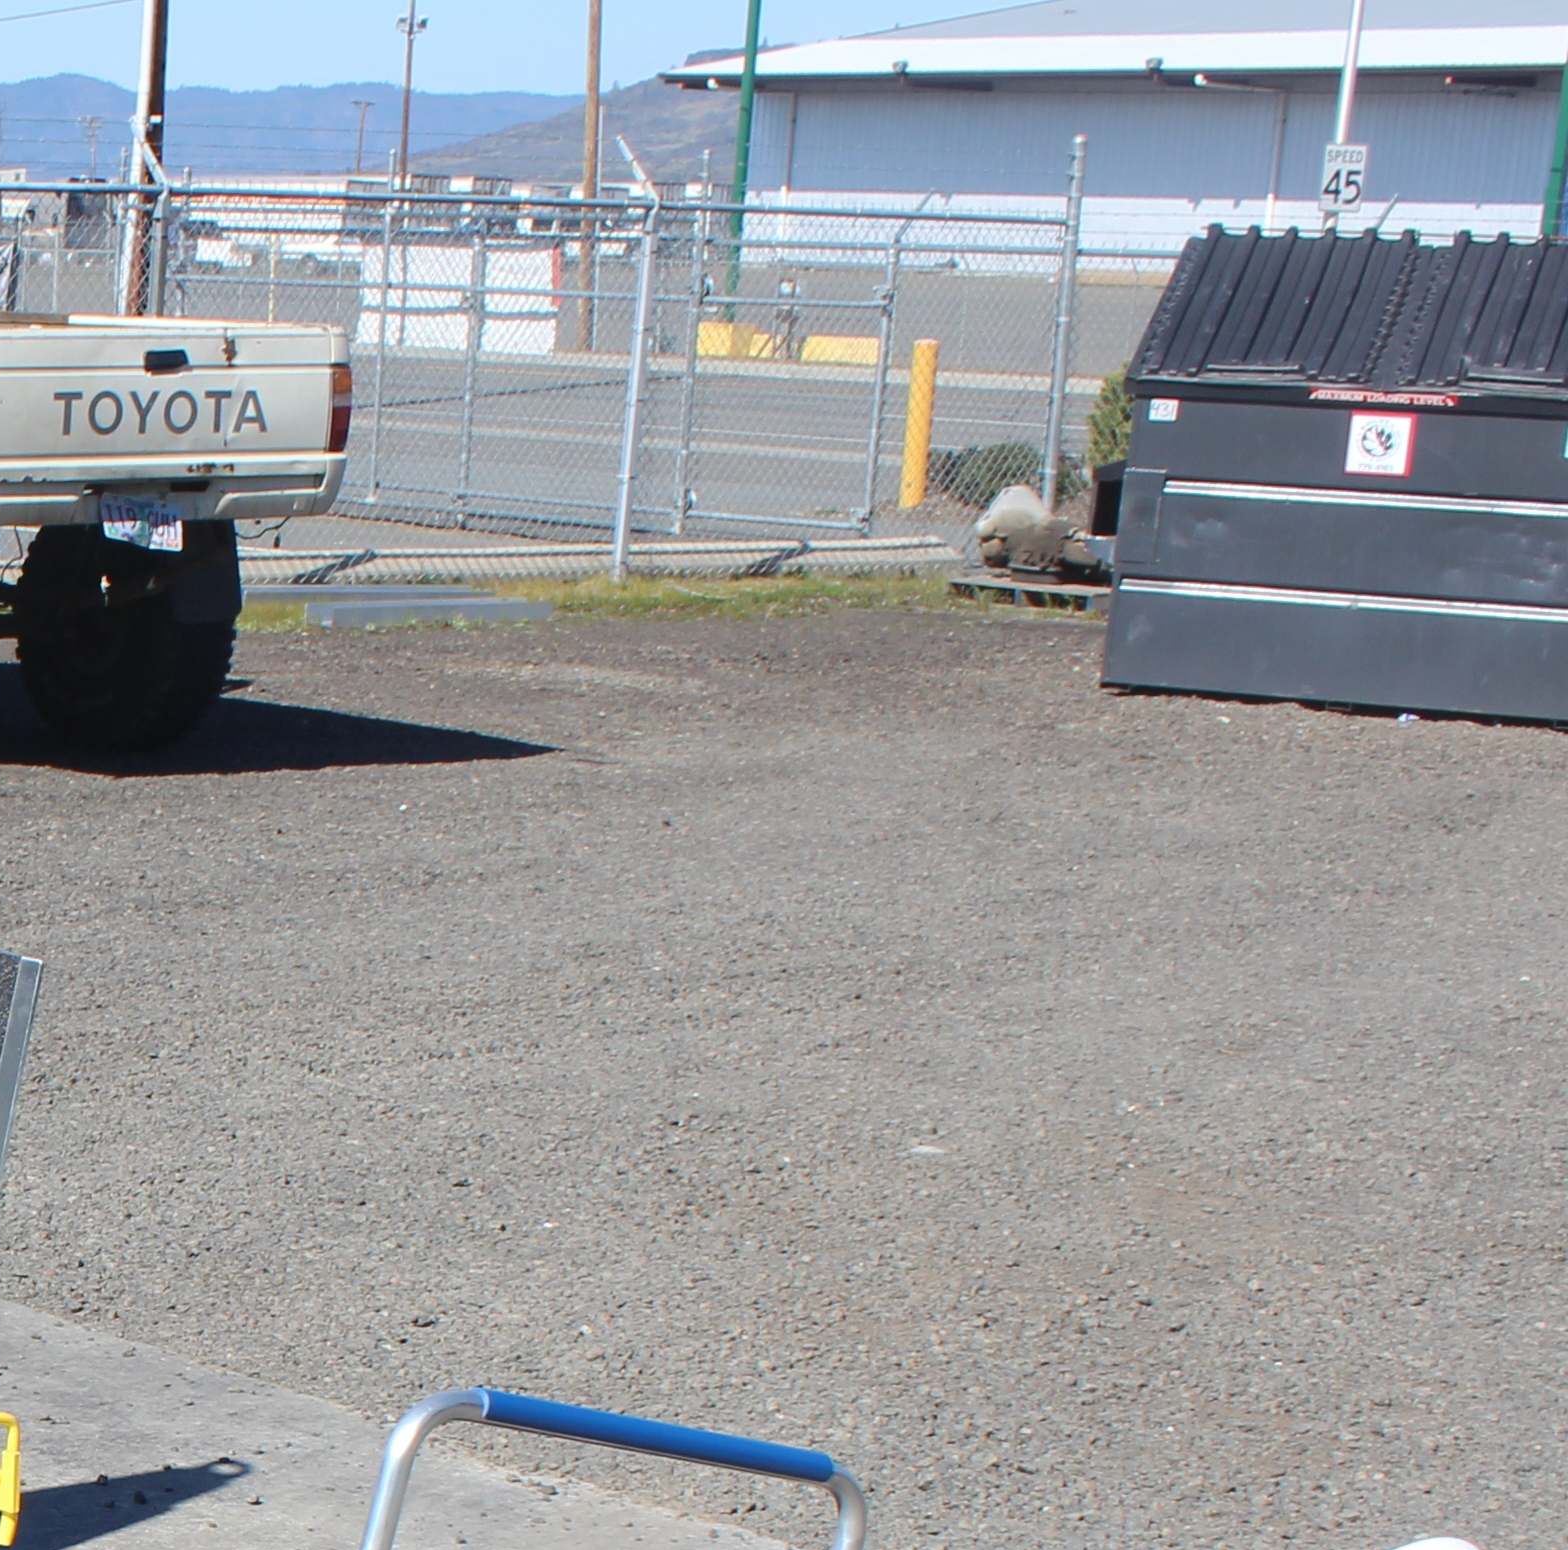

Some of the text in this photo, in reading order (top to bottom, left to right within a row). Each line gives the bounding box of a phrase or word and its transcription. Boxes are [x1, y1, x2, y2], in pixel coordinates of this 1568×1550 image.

[1327, 149, 1364, 164] SPEED
[1322, 168, 1363, 205] 45
[1367, 392, 1411, 405] LOADING
[1413, 395, 1446, 406] LEVEL
[53, 389, 268, 436] TOYOTA
